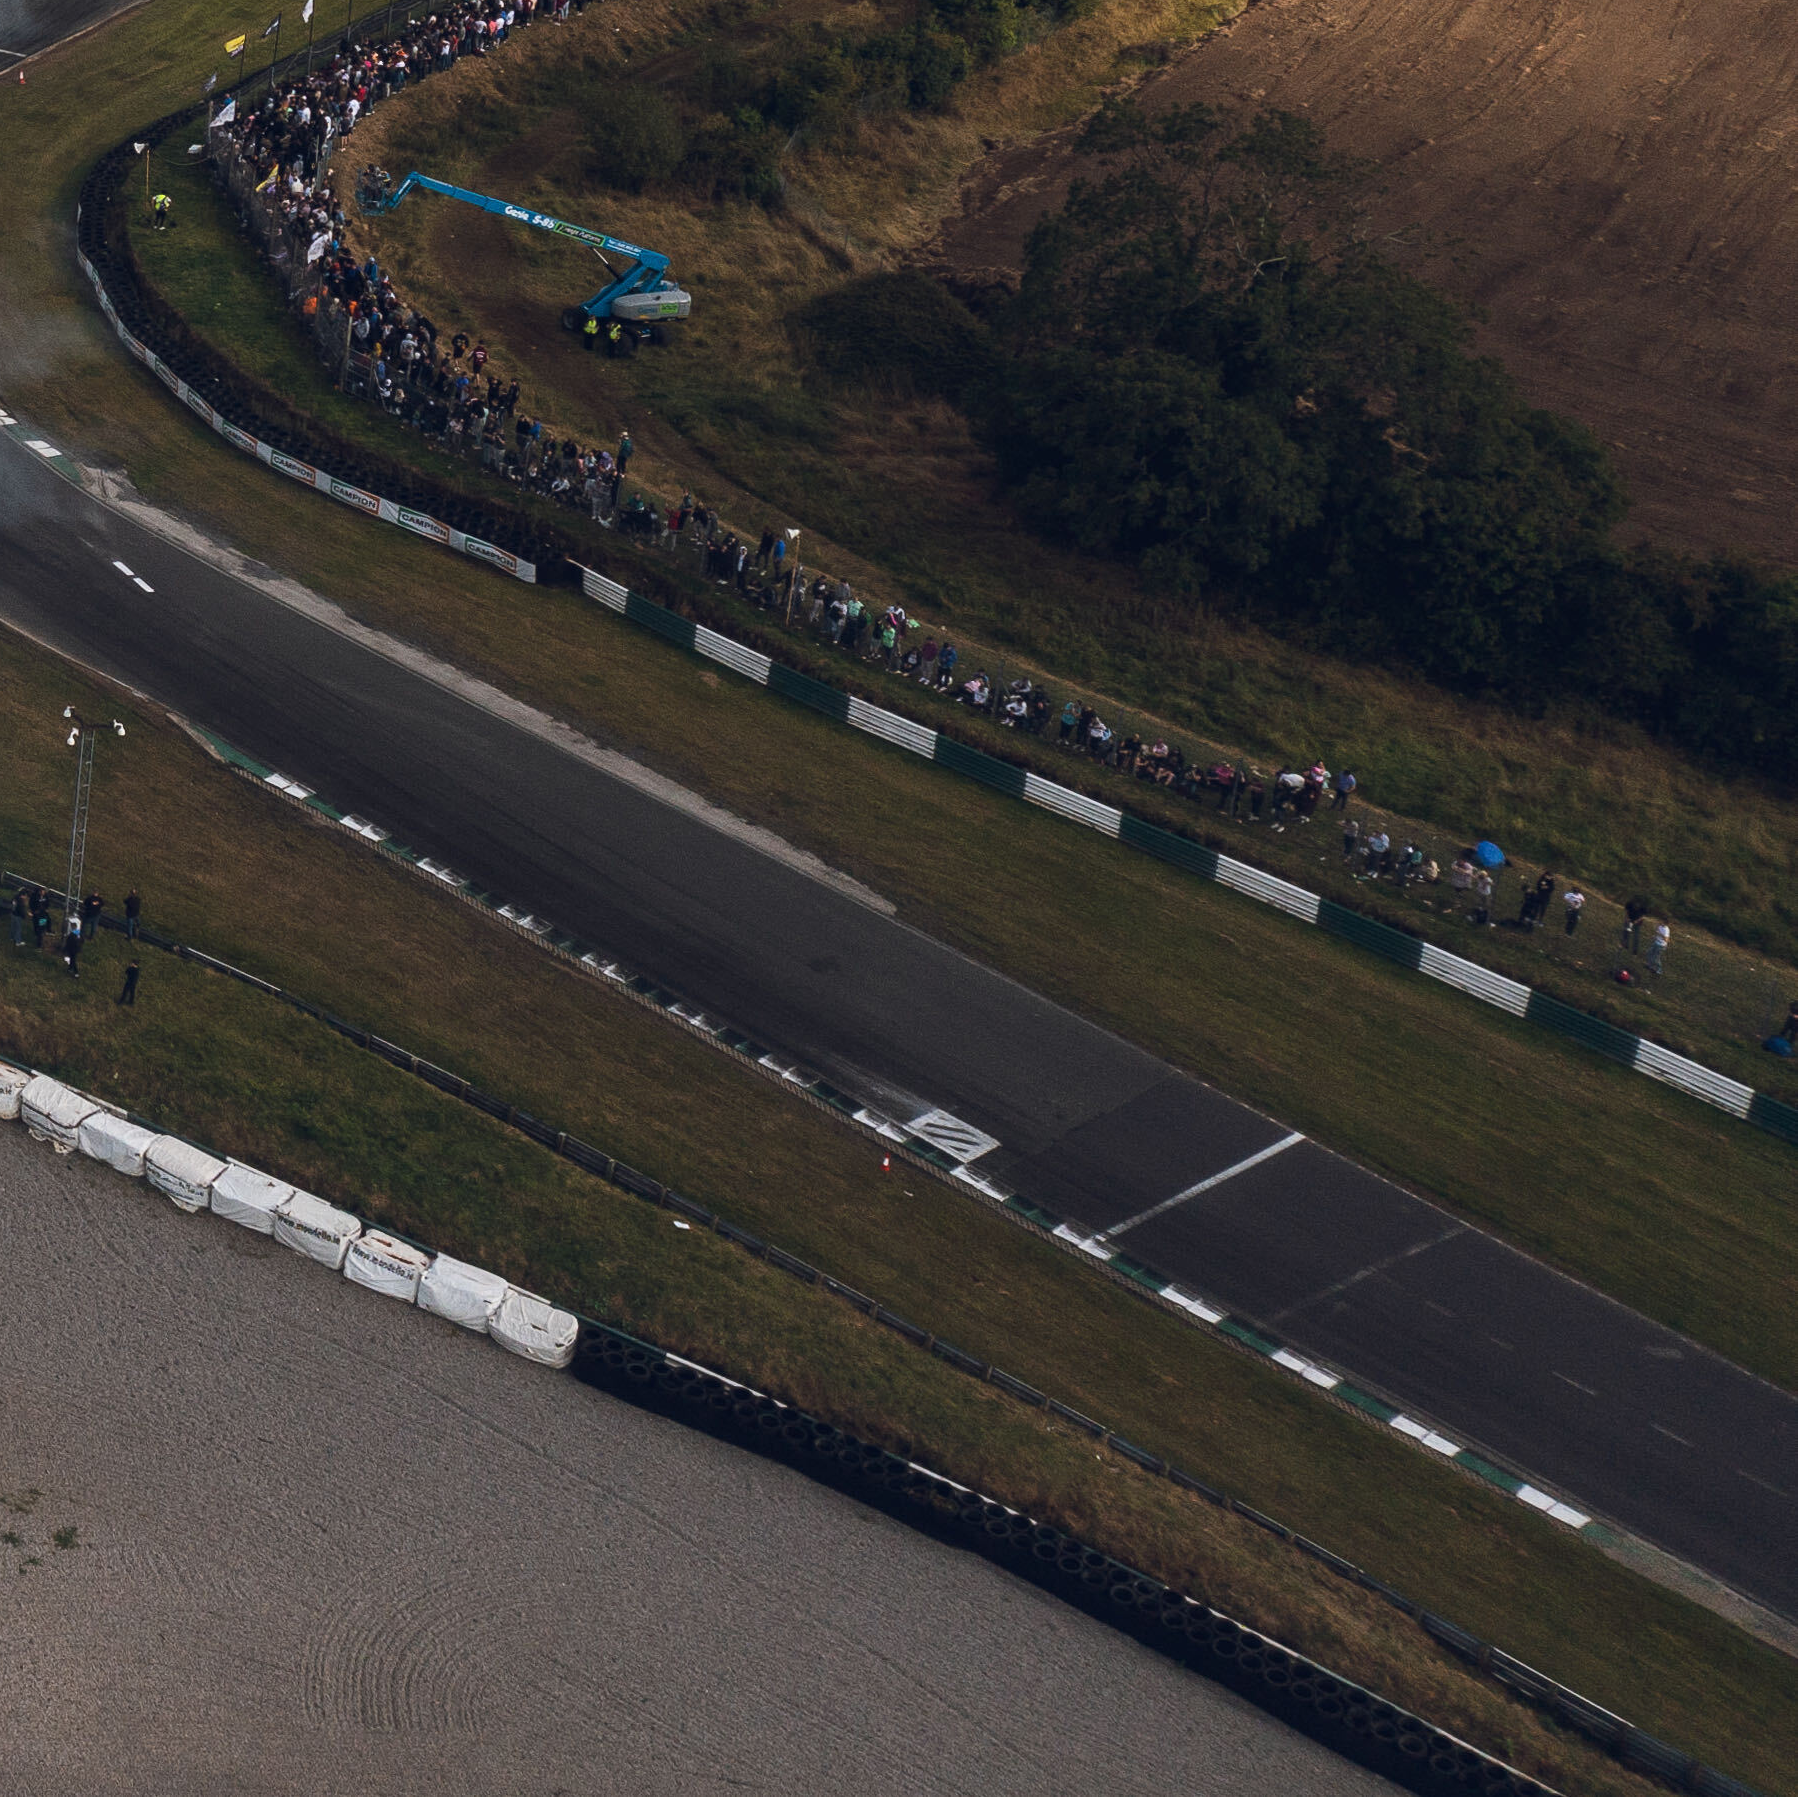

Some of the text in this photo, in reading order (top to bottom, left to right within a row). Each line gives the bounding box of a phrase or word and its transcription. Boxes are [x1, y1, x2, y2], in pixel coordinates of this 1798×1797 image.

[273, 456, 313, 479] CAMPION
[333, 485, 377, 509] CAMPION
[401, 514, 448, 537] CAMPION
[468, 543, 515, 568] CAMPION
